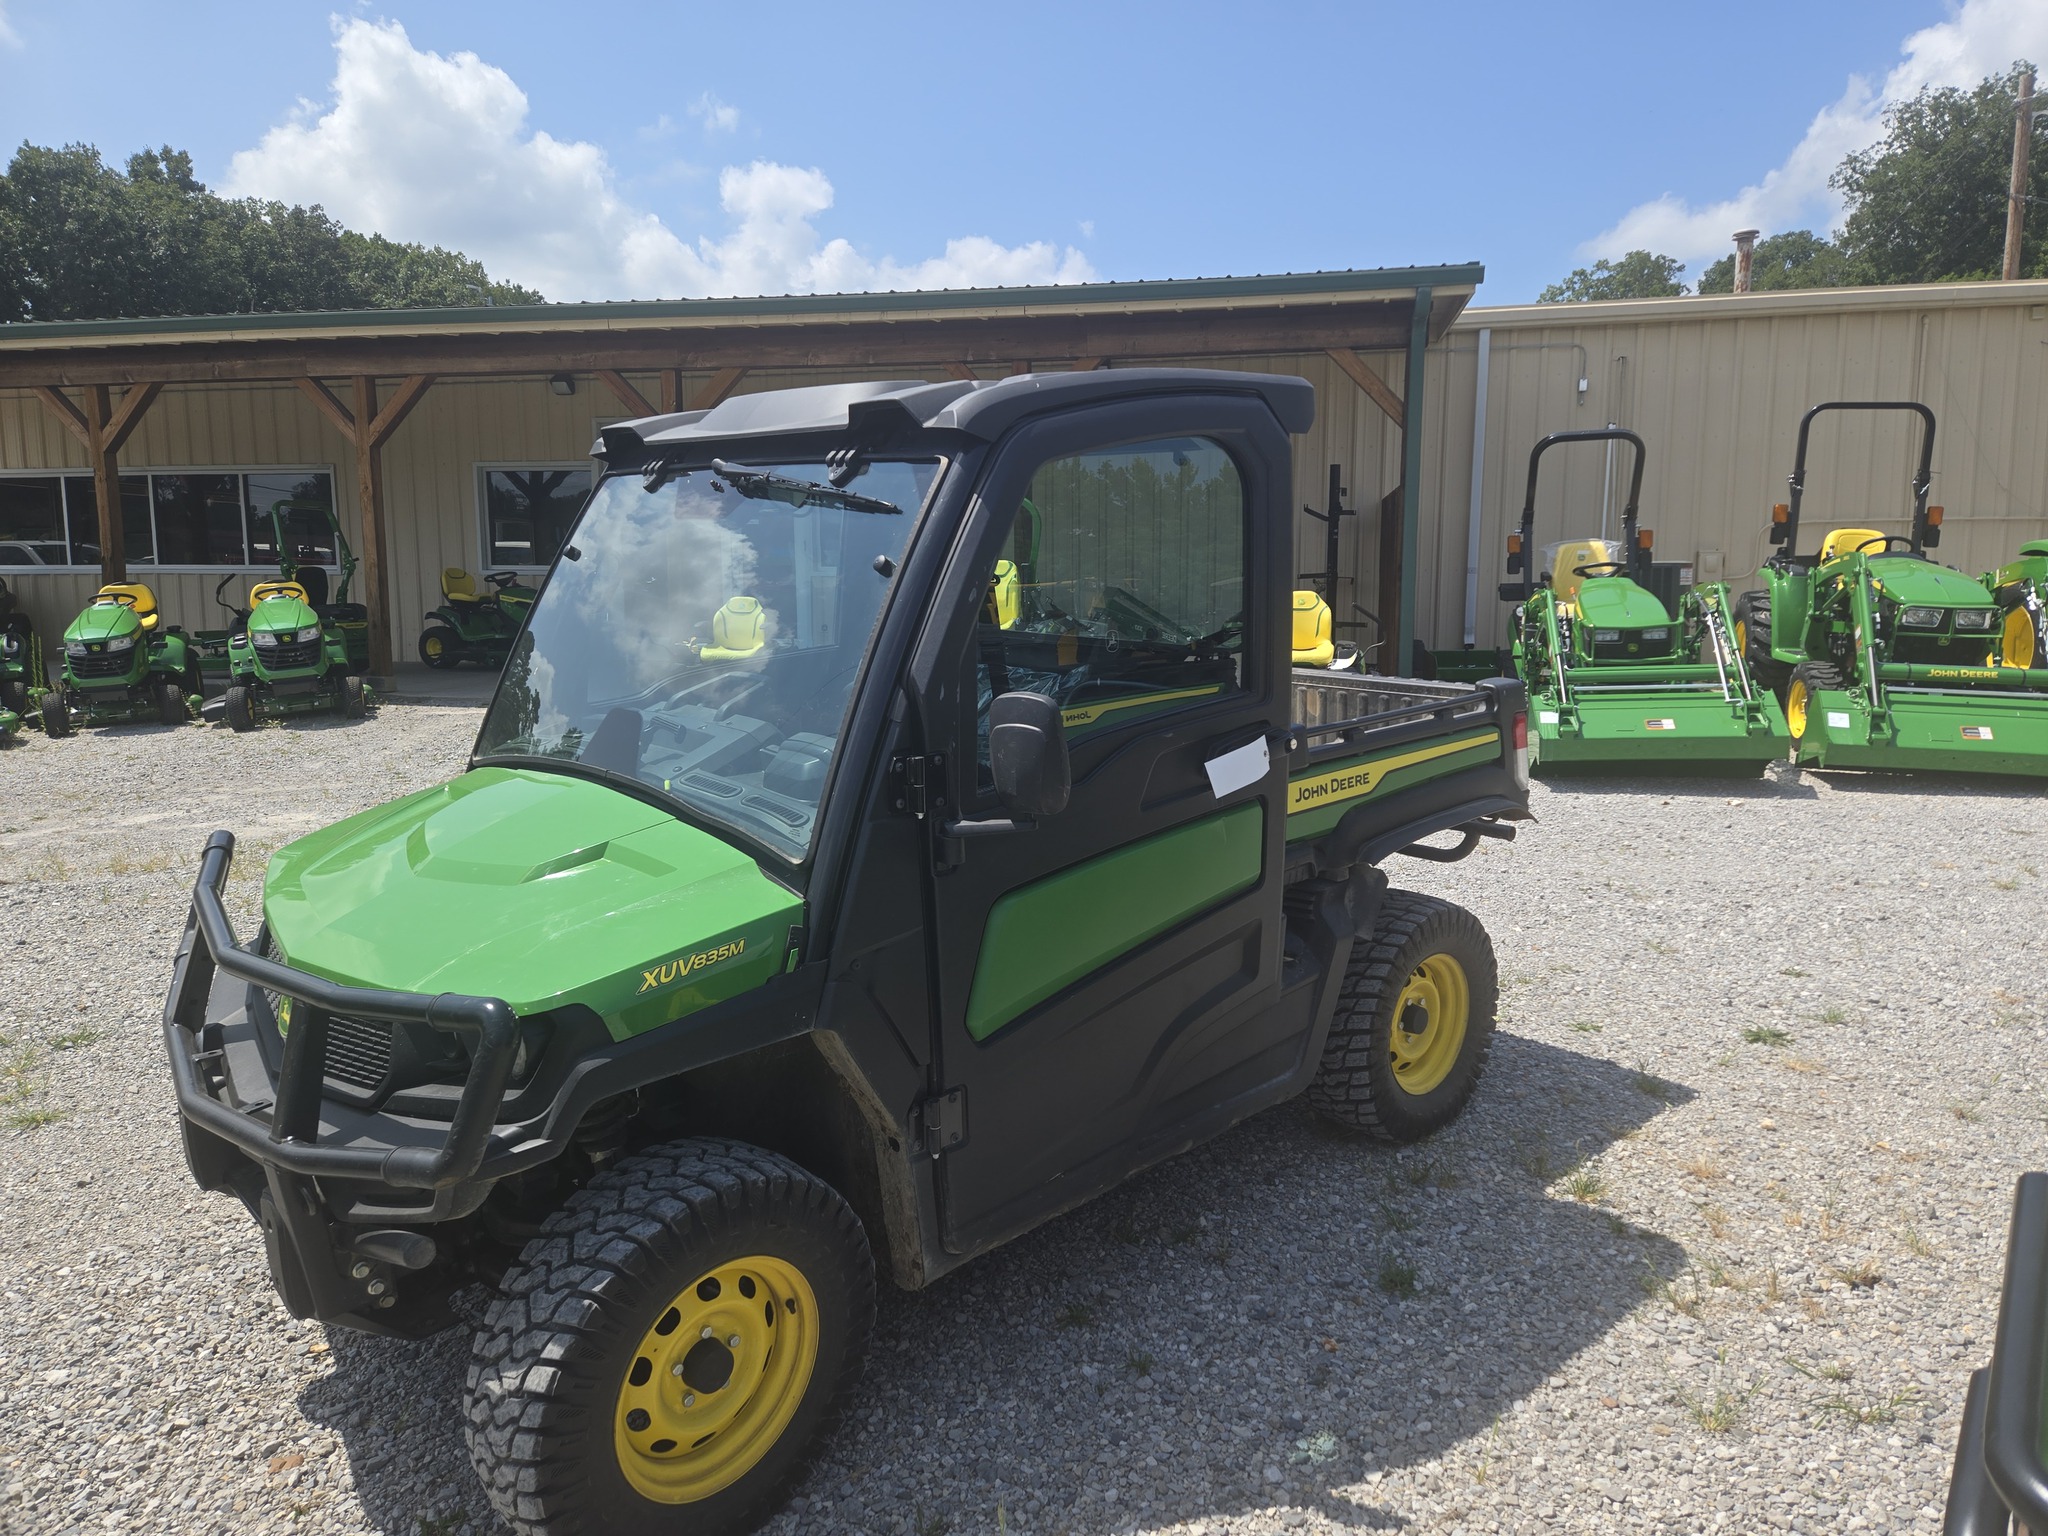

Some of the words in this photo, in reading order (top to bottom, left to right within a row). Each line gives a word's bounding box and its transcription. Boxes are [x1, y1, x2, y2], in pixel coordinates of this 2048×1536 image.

[1927, 668, 1958, 677] JOHN
[1960, 669, 1998, 679] DEERE
[1295, 783, 1328, 803] JOHN
[1331, 772, 1370, 793] DEERE
[639, 939, 745, 992] XUV835M
